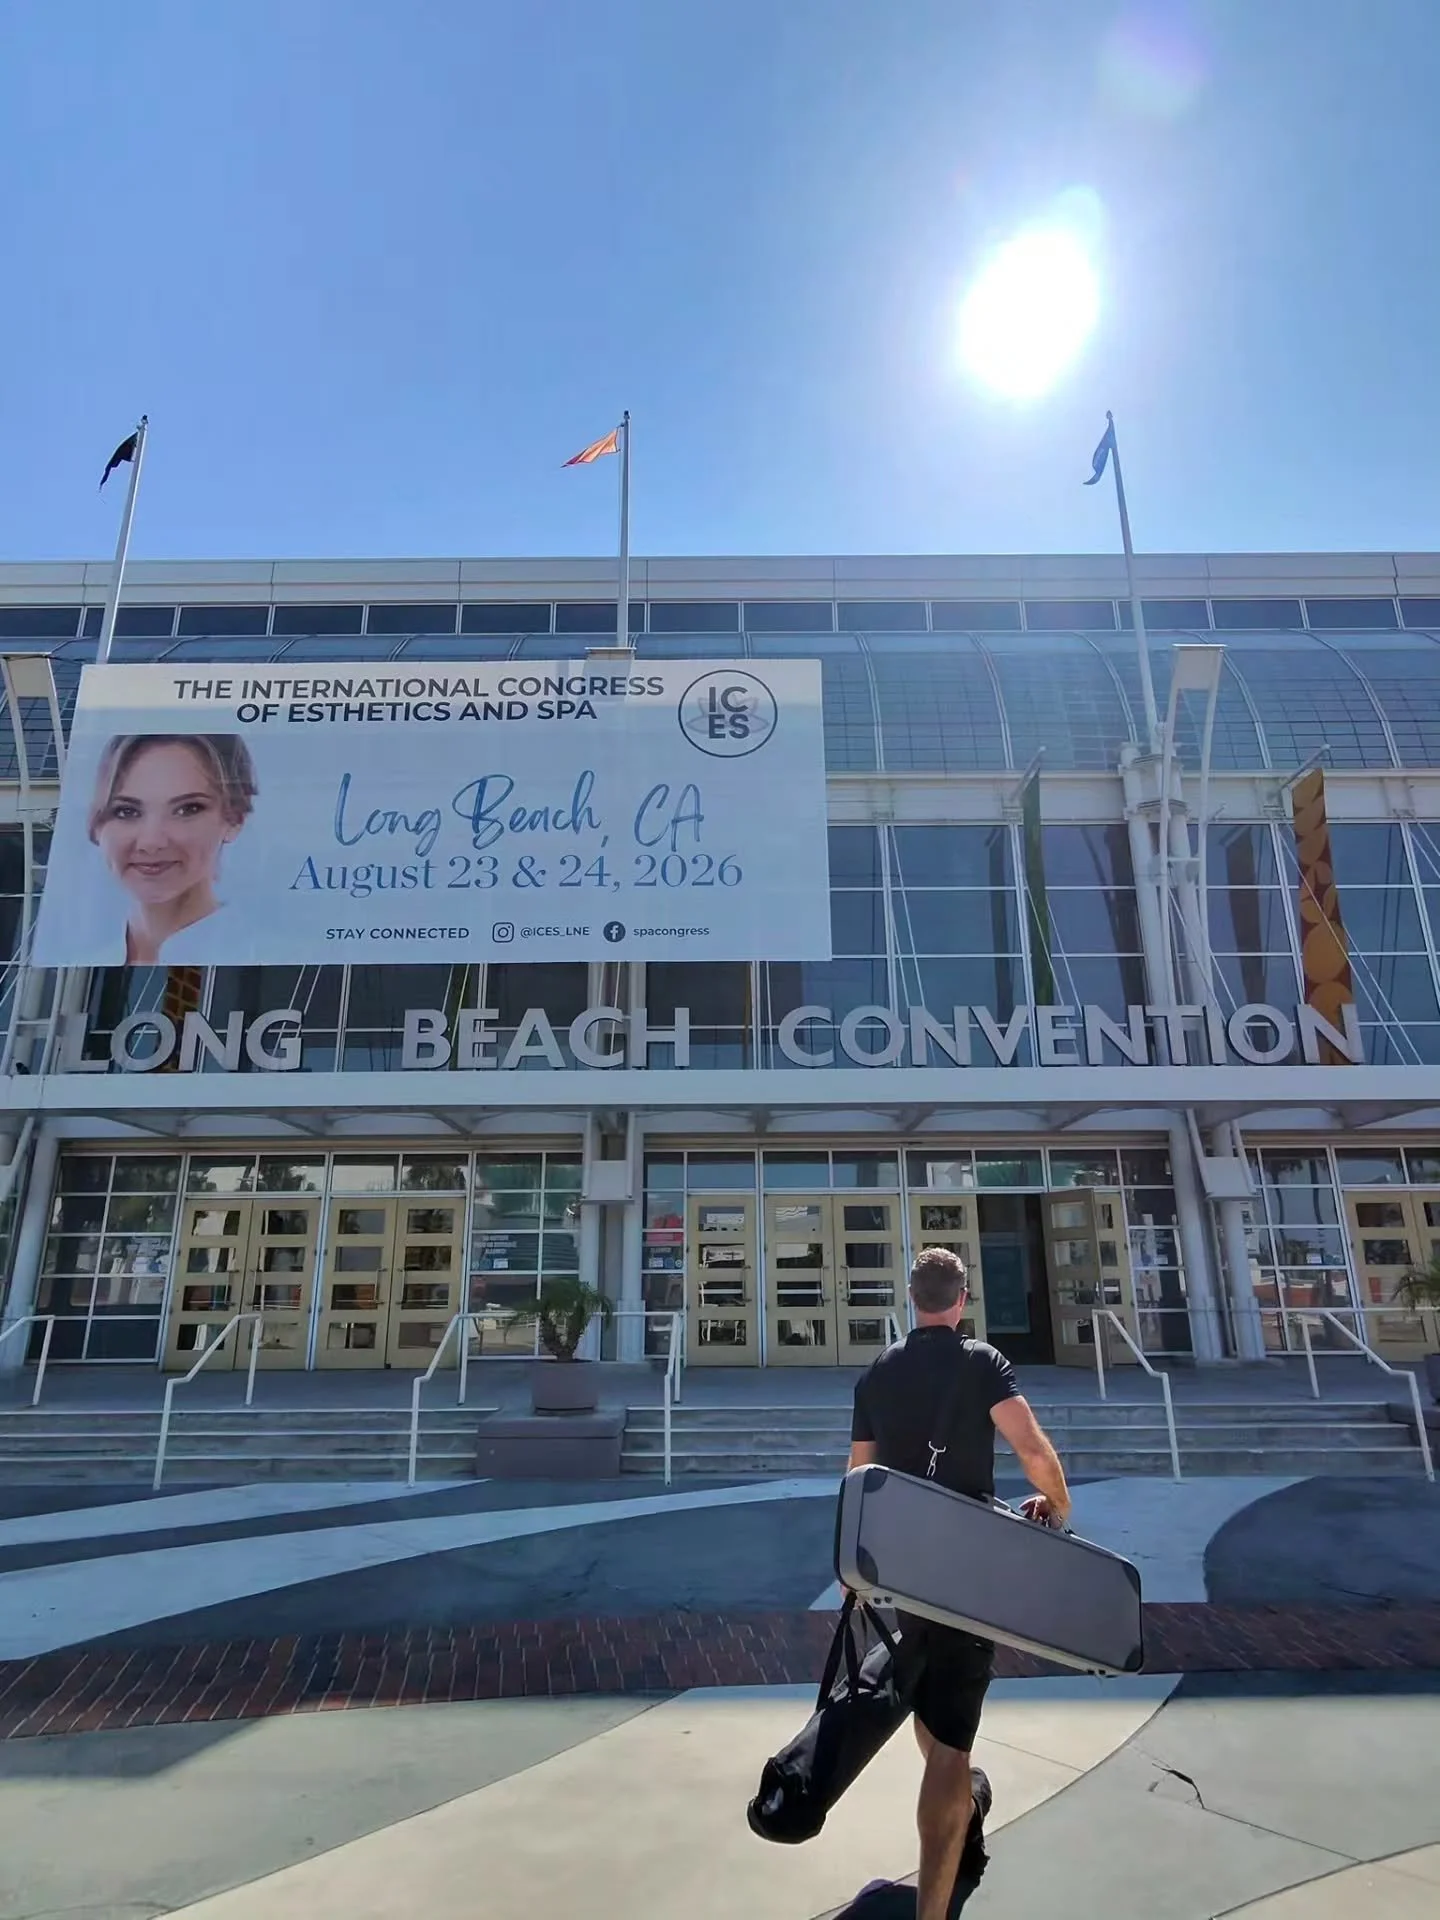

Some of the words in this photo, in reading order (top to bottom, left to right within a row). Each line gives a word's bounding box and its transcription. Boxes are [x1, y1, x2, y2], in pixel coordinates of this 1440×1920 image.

[173, 679, 233, 700] THE
[241, 677, 490, 699] INTERNATIONAL
[497, 675, 665, 697] CONGRESS
[708, 686, 750, 713] IC
[236, 703, 280, 723] OF
[287, 701, 451, 723] ESTHETICS
[458, 700, 529, 721] AND
[536, 699, 598, 720] SPA
[708, 714, 750, 740] ES
[334, 772, 442, 858] Long
[451, 769, 609, 850] Beach,
[633, 783, 705, 853] CA
[288, 855, 439, 899] August
[447, 855, 499, 889] 23
[511, 855, 547, 888] &
[558, 853, 621, 893] 24,
[633, 853, 743, 888] 2026
[325, 928, 366, 941] STAY
[369, 927, 471, 940] CONNECTED
[520, 926, 591, 939] @ICES_LNE
[632, 926, 711, 939] spacongress
[67, 1008, 303, 1073] LONG
[402, 1006, 691, 1070] BEACH
[777, 1002, 1365, 1068] CONVENTION
